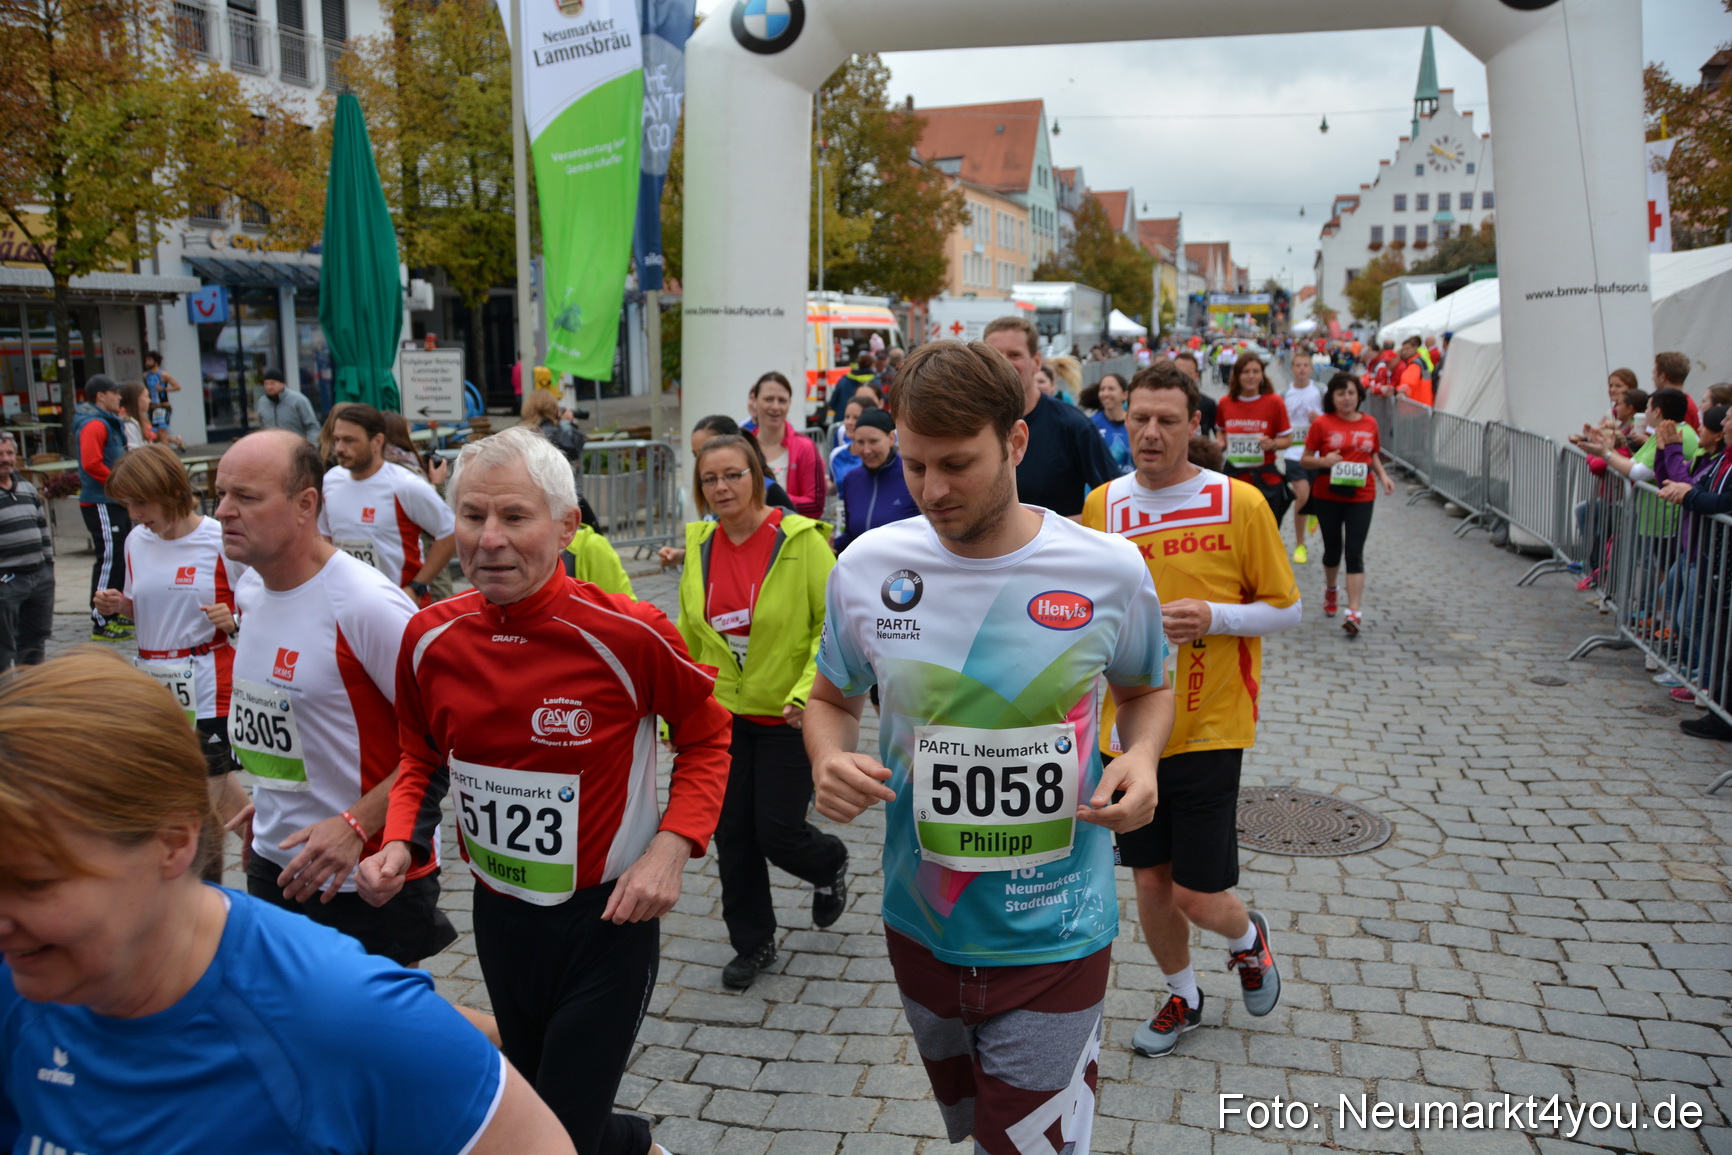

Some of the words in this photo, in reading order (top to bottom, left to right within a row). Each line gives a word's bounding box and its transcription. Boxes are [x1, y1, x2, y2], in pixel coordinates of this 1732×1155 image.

[542, 18, 614, 43] Neumarkter
[533, 32, 631, 66] Lammsbräu
[643, 64, 673, 93] HE
[642, 94, 662, 120] AY
[1232, 442, 1260, 454] 5043
[1137, 543, 1156, 560] X
[1163, 532, 1232, 557] BÖGL
[1037, 599, 1087, 620] Hervis
[876, 618, 921, 631] PARTL
[876, 630, 920, 640] Neumarkt
[492, 635, 519, 643] CRAFT
[730, 641, 747, 649] Neum
[274, 666, 292, 679] DKMS
[246, 693, 277, 709] Neumarkt
[543, 697, 582, 706] Laufteam
[234, 704, 292, 752] 5305
[531, 735, 561, 747] Kraftsport
[569, 738, 592, 747] Fitness
[919, 739, 970, 757] PARTL
[974, 742, 1049, 758] Neumarkt
[451, 768, 482, 790] PARTL
[485, 780, 552, 799] Neumarkt
[931, 762, 1064, 817] 5058
[460, 791, 562, 856] 5123
[960, 831, 1033, 856] Philipp
[487, 855, 527, 884] Horst
[1005, 871, 1081, 895] Neumarkter
[1005, 889, 1069, 912] Stadtlauf
